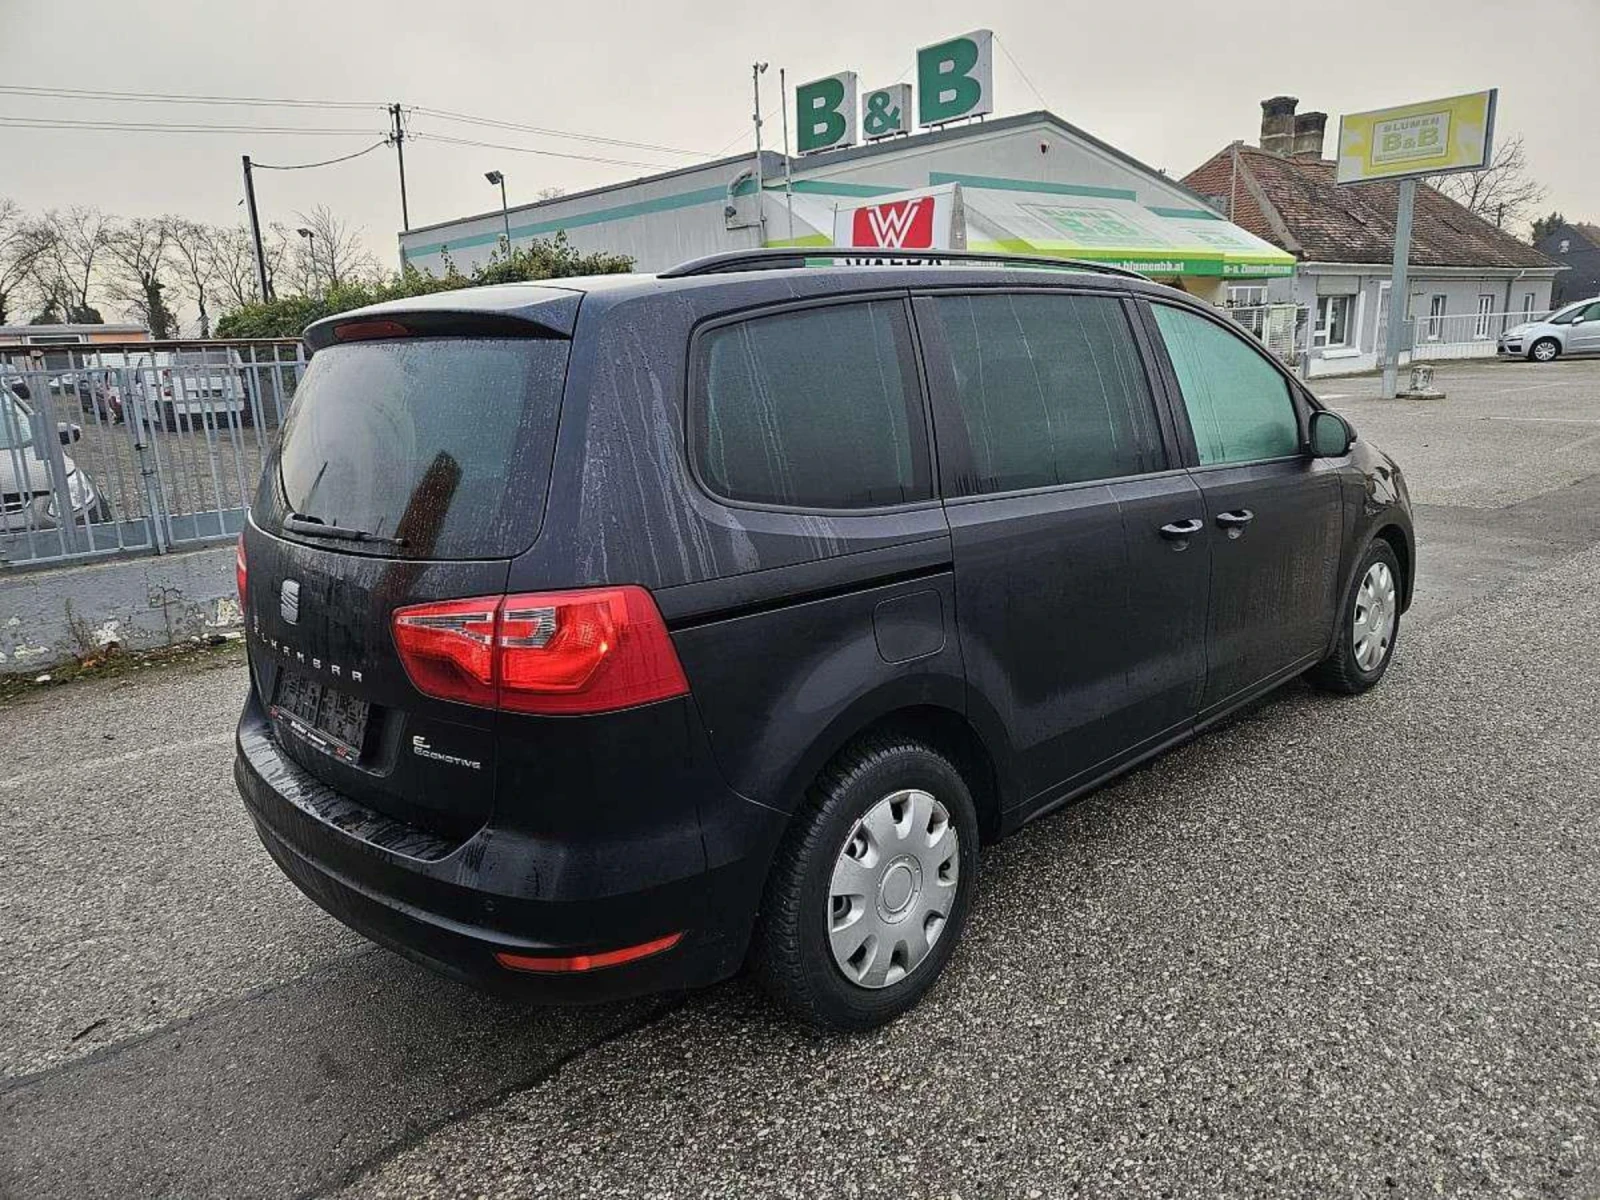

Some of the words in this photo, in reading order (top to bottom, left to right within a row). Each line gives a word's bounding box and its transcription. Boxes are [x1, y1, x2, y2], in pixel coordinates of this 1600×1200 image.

[797, 77, 846, 152] B
[864, 91, 901, 135] &
[918, 38, 982, 125] B
[866, 198, 923, 248] W
